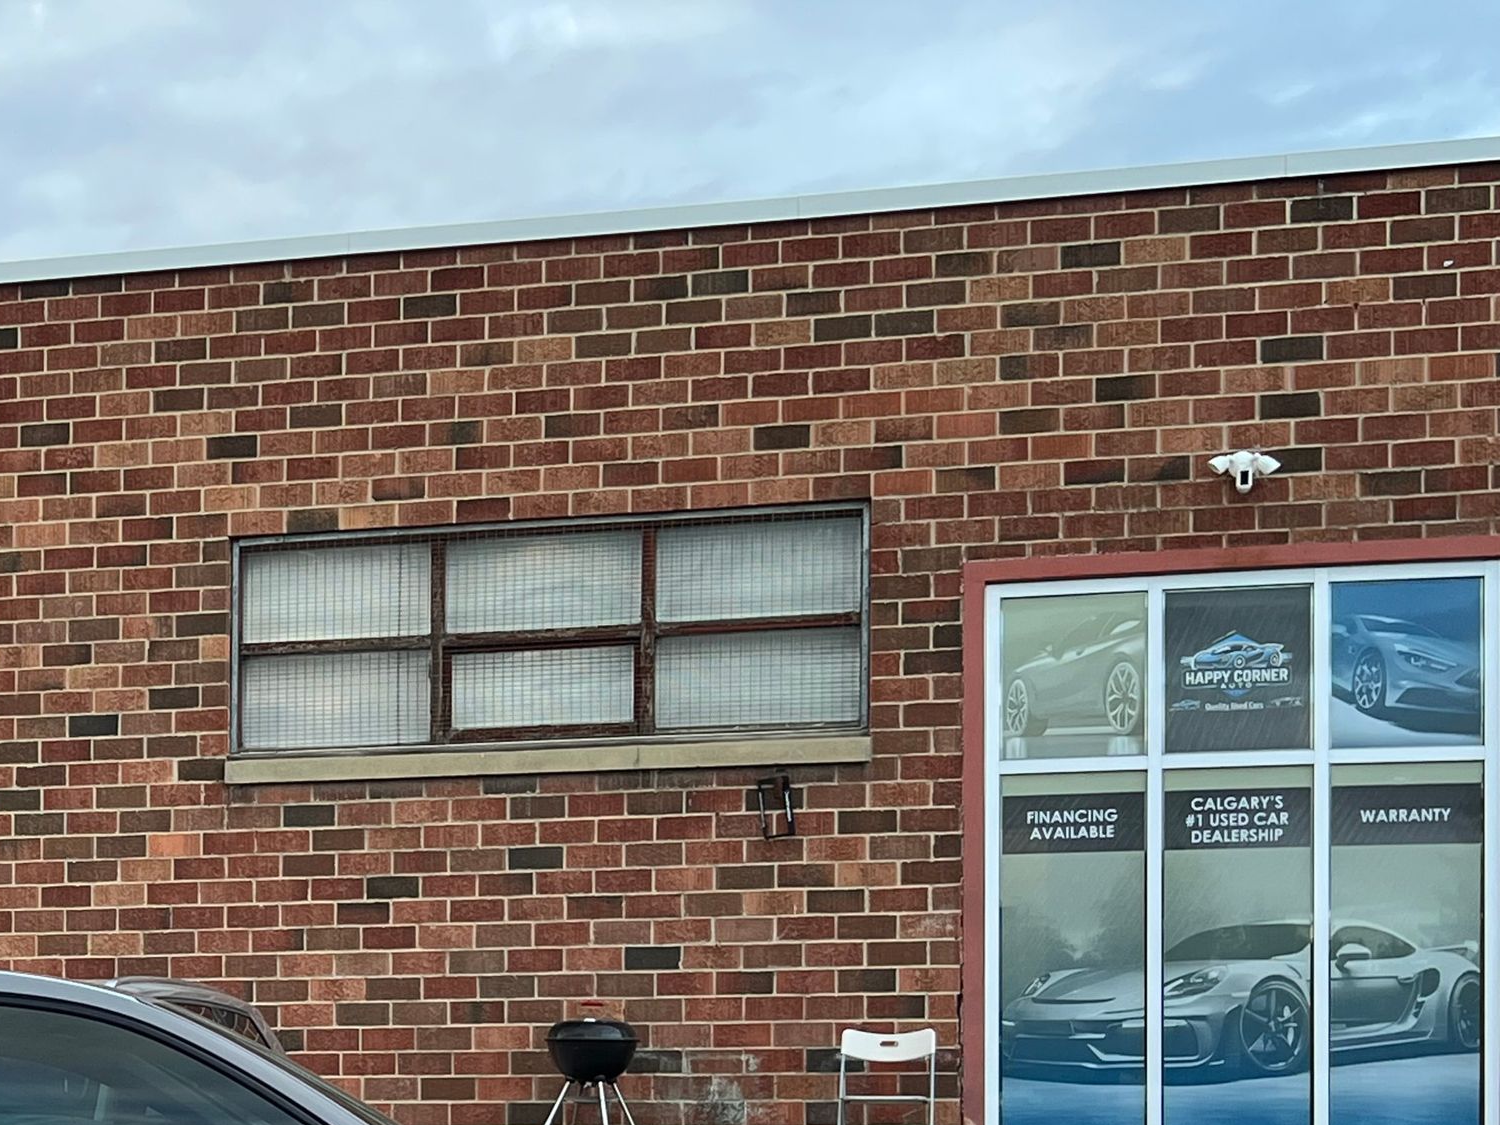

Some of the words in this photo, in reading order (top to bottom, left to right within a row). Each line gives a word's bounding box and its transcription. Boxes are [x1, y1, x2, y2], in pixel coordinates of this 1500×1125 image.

[1185, 669, 1231, 685] HAPPY
[1233, 668, 1288, 682] CORNER
[1248, 701, 1264, 710] Cars
[1190, 795, 1284, 811] CALGARY'S
[1026, 808, 1118, 824] FINANCING
[1185, 814, 1203, 827] #1
[1209, 813, 1250, 827] USED
[1253, 812, 1289, 826] CAR
[1360, 807, 1451, 823] WARRANTY
[1029, 824, 1115, 840] AVAILABLE
[1191, 828, 1283, 844] DEALERSHIP
